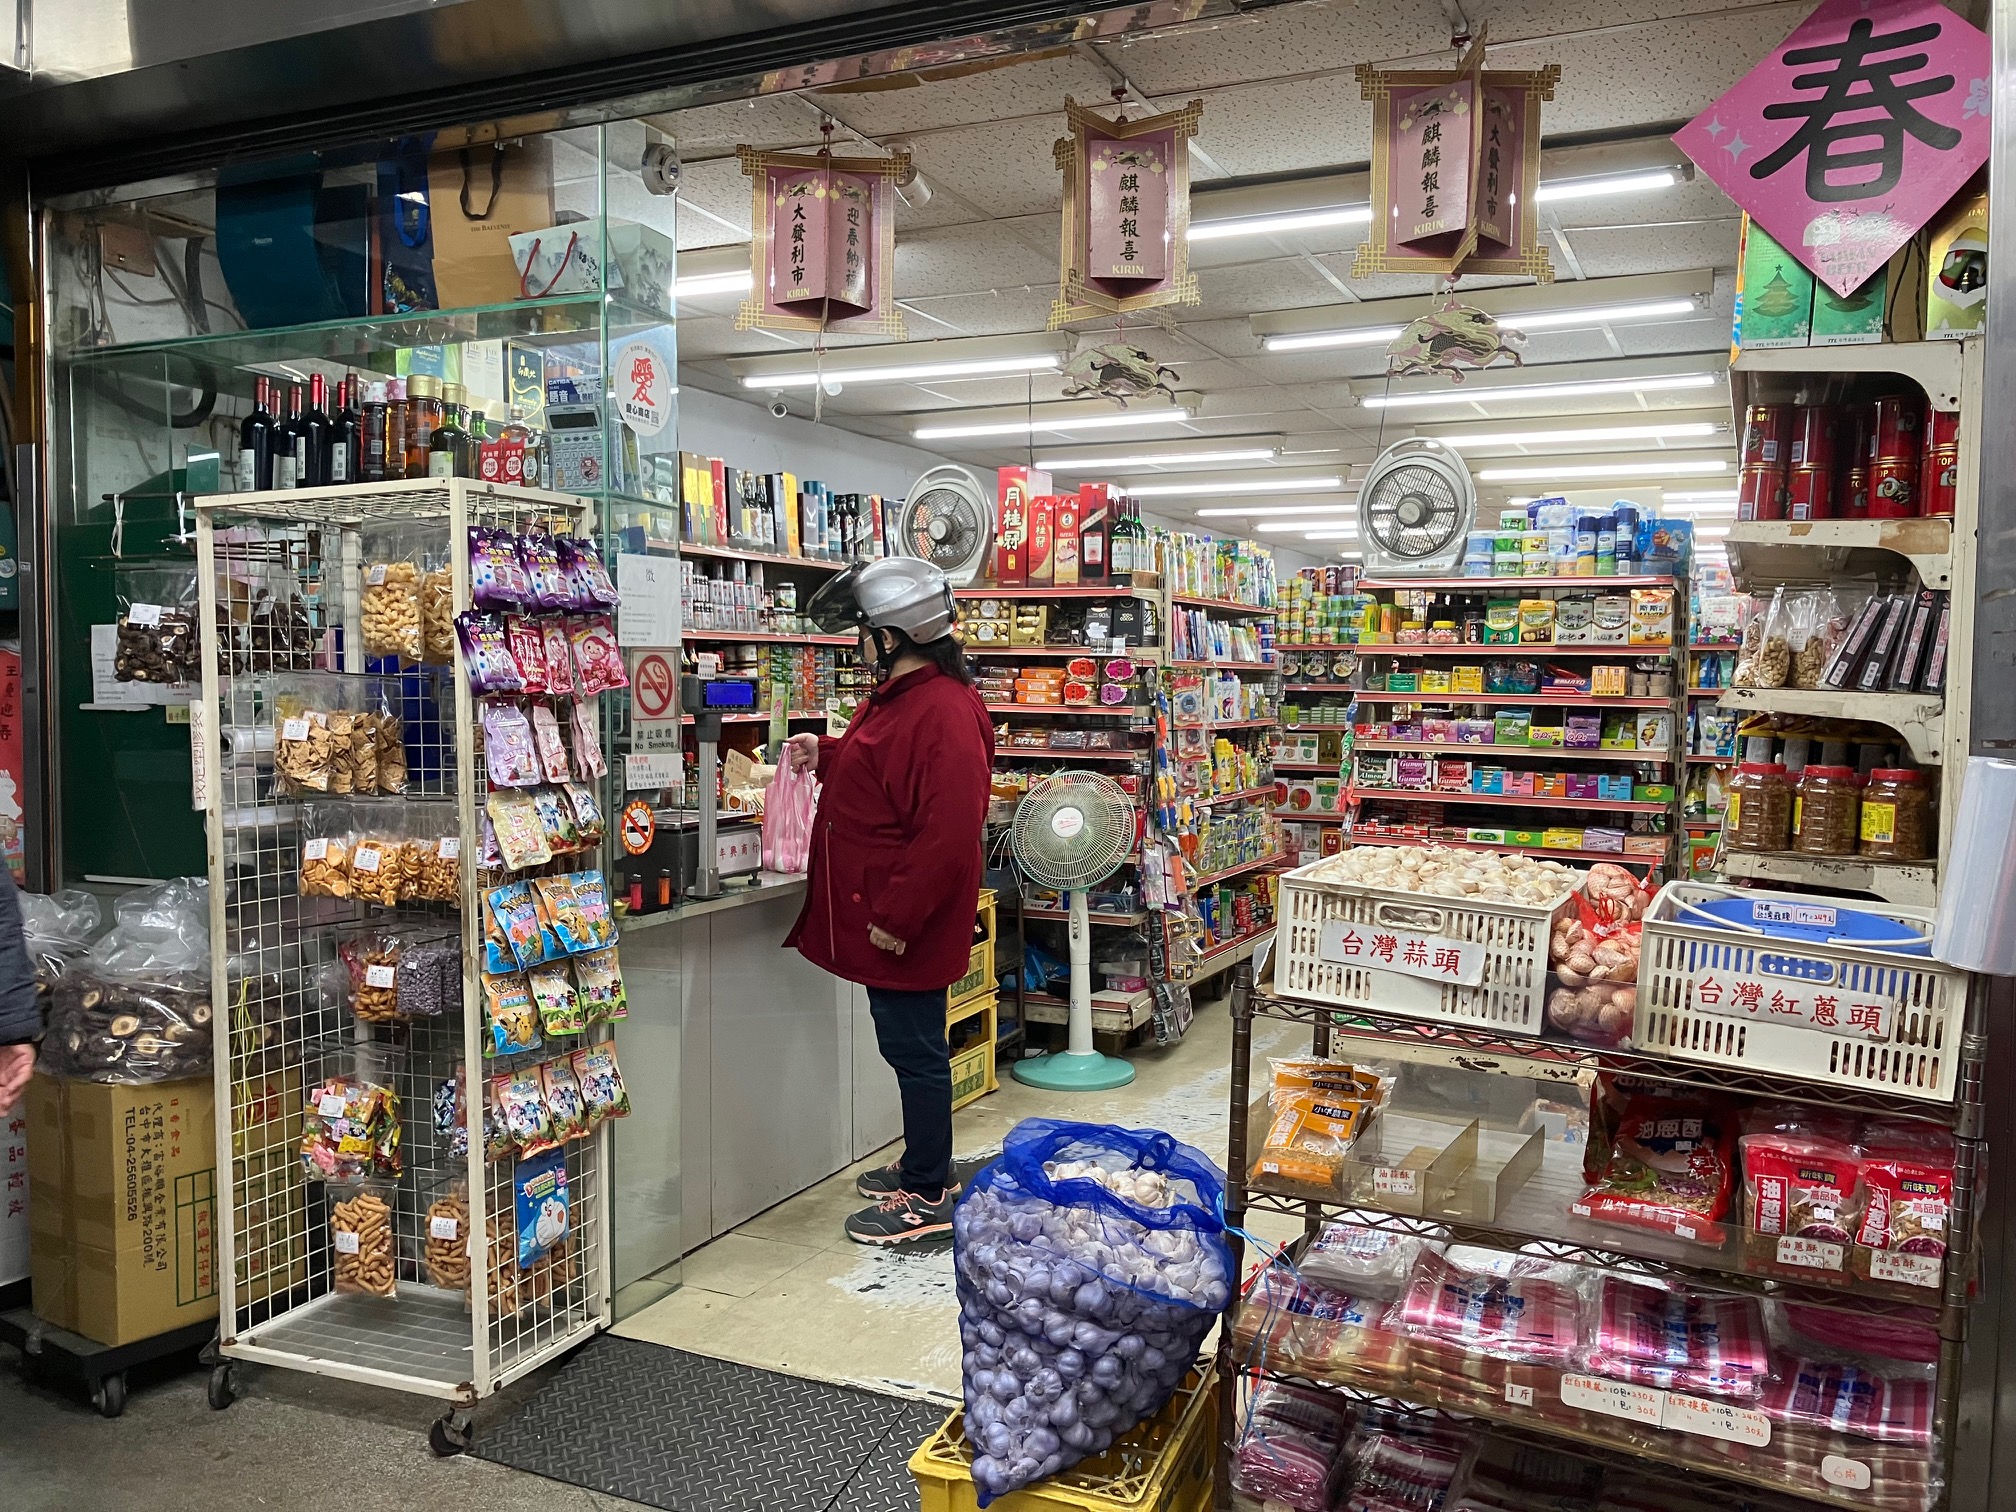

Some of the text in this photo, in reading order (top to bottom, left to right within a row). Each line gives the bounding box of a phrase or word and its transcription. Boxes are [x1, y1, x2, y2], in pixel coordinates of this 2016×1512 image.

[1749, 17, 1964, 203] 春
[1420, 121, 1443, 218] 麒麟報喜
[1486, 123, 1501, 220] 大發利市
[1118, 173, 1141, 261] 麒麟報喜
[1414, 218, 1445, 236] KIRIN
[1480, 220, 1501, 237] KIRIN
[791, 202, 807, 286] 大發利市
[1112, 264, 1144, 275] KIRIN
[786, 287, 810, 299] KIRIN
[549, 390, 569, 403] 語音
[625, 402, 650, 419] 愛心商店
[1002, 486, 1022, 551] 月桂冠
[1035, 512, 1047, 548] 月桂冠
[637, 728, 672, 741] 禁止吸煙
[634, 742, 644, 750] No
[1399, 760, 1426, 768] Gummy
[1441, 762, 1467, 770] Gummy
[1398, 775, 1425, 784] Gummy
[1438, 777, 1466, 786] Gummy
[1342, 930, 1461, 976] 台灣蒜頭
[1698, 976, 1884, 1035] 台灣紅蔥頭
[125, 1106, 138, 1222] TEL:04-25605526
[1378, 1169, 1410, 1180] 油蒜酥
[1780, 1239, 1818, 1253] 油蔥酥
[1875, 1255, 1915, 1268] 油蔥酥
